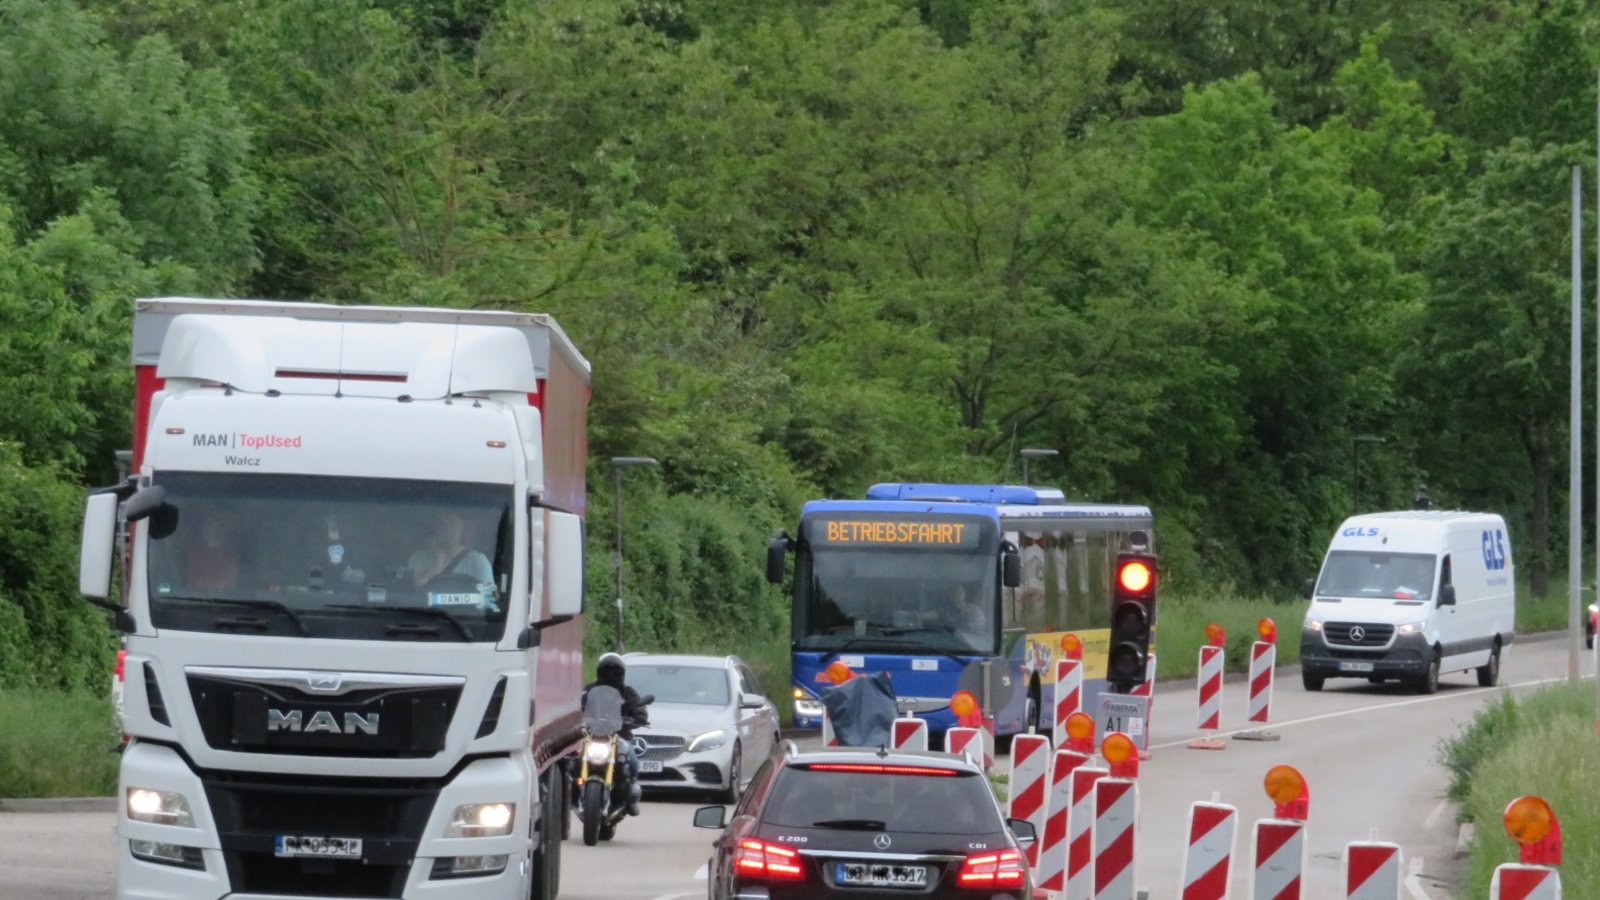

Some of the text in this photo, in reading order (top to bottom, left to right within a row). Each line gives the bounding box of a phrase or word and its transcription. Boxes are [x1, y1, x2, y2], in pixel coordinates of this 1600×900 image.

[193, 433, 302, 450] MAN TopUsed
[827, 521, 965, 543] BETRIEBSFAHRT
[1342, 527, 1380, 537] GLS
[1482, 529, 1505, 571] GLS
[440, 594, 472, 604] DAWID
[267, 708, 380, 735] MAN
[786, 835, 808, 843] 200
